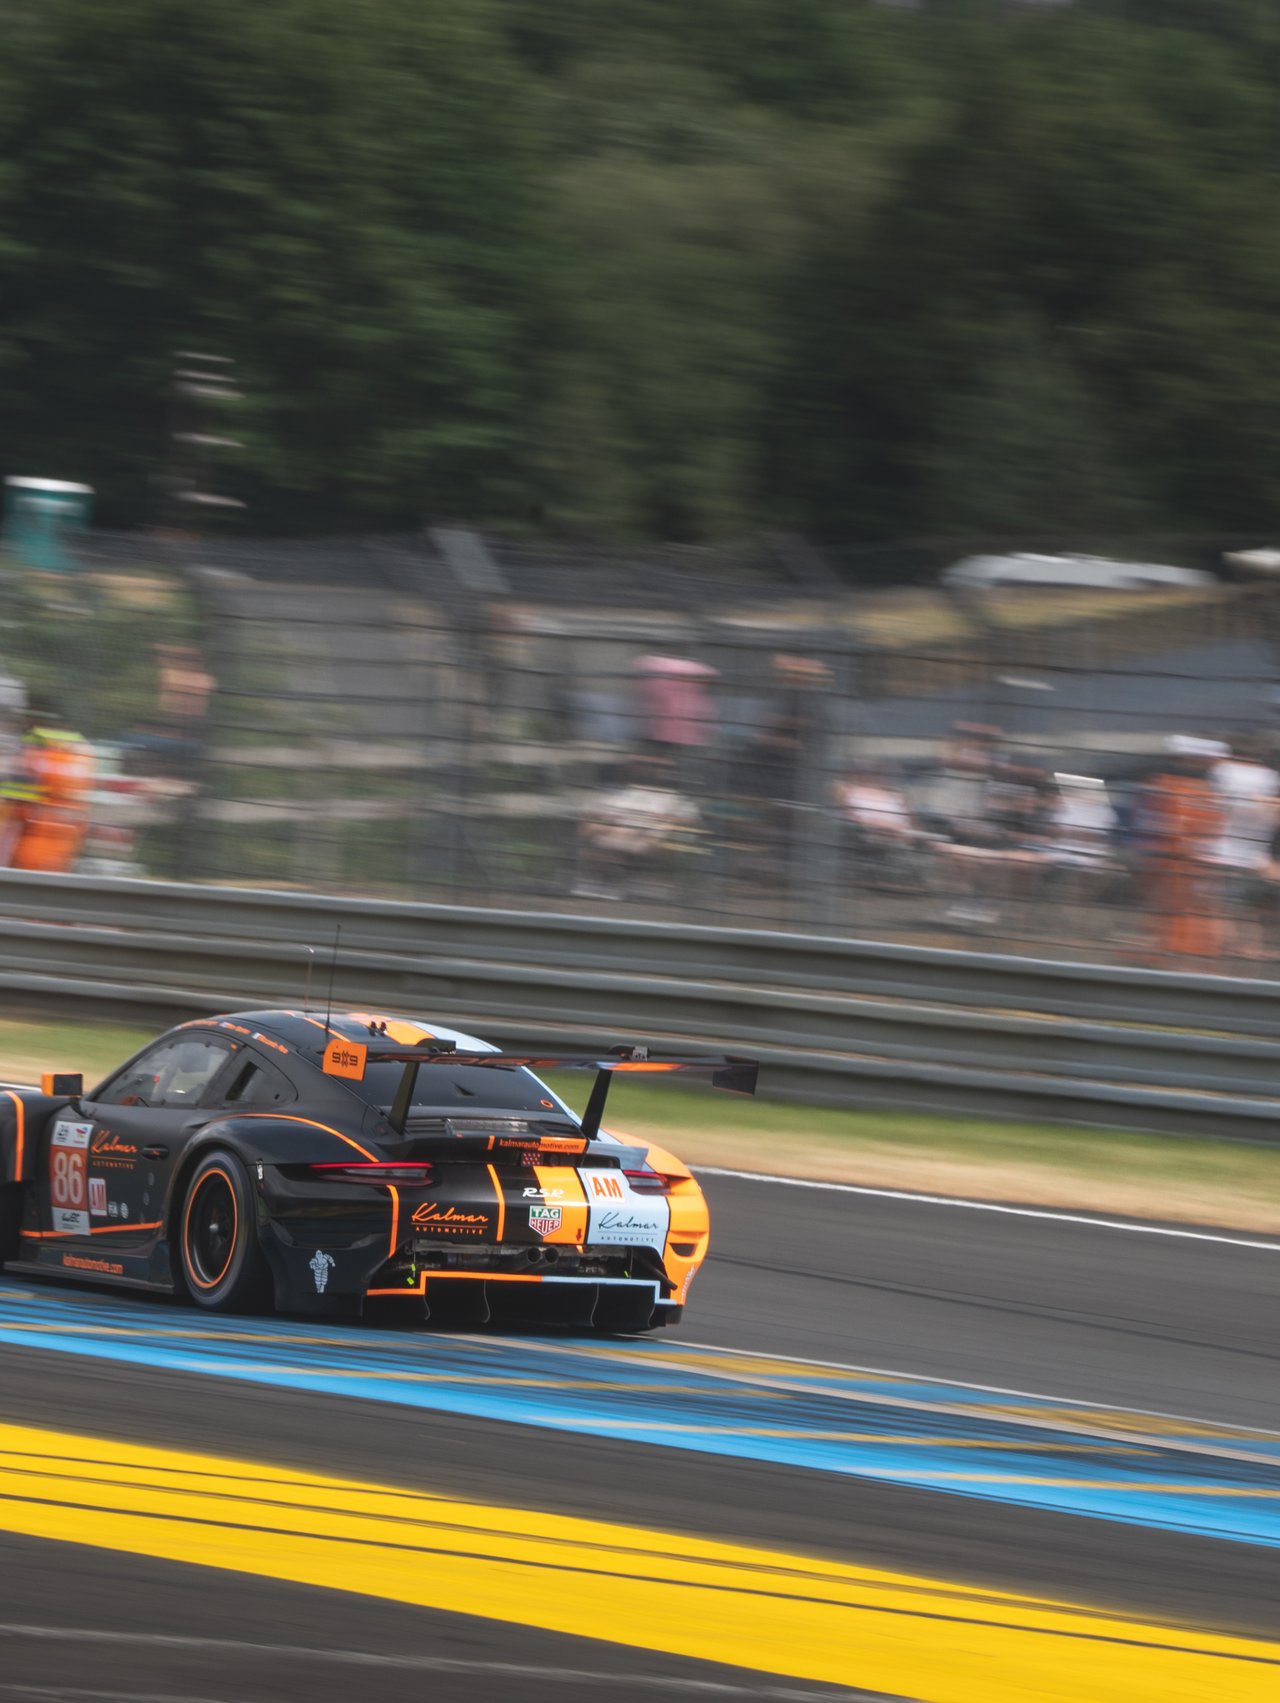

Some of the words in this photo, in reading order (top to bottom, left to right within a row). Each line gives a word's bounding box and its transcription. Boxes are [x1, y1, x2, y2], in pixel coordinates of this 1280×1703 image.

[54, 1151, 82, 1205] 86
[522, 1187, 565, 1199] RSR
[592, 1176, 623, 1199] AM
[412, 1202, 489, 1223] Kalmar
[533, 1207, 561, 1219] TAG
[597, 1212, 660, 1230] Kalmar
[415, 1226, 484, 1236] AUTOMOTIVE
[530, 1218, 561, 1235] HEUER
[600, 1235, 655, 1244] AUTOMOTIVE
